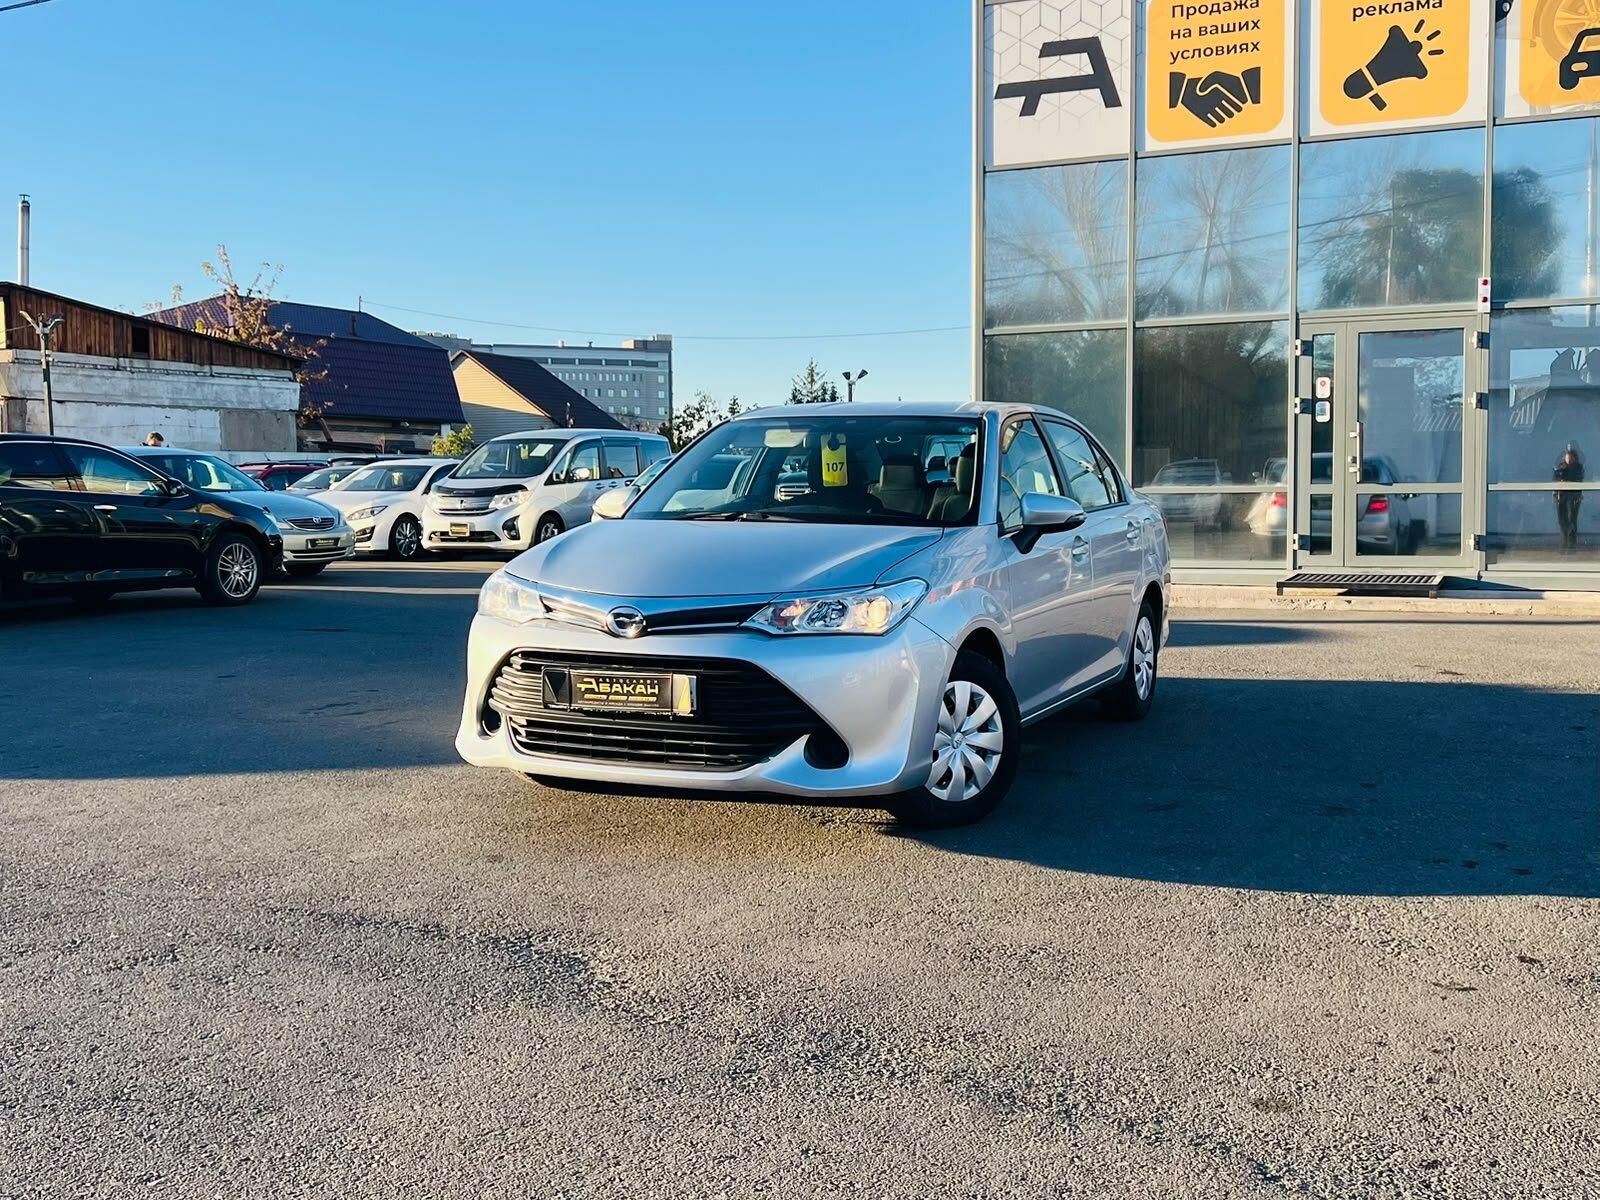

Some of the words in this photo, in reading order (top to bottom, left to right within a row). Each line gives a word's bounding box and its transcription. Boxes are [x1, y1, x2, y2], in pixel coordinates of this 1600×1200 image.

[1172, 0, 1260, 19] Продажа
[1353, 0, 1443, 22] реклама
[1170, 28, 1192, 40] на
[1198, 19, 1260, 37] ваших
[1169, 41, 1260, 65] условиях
[826, 461, 845, 473] 107
